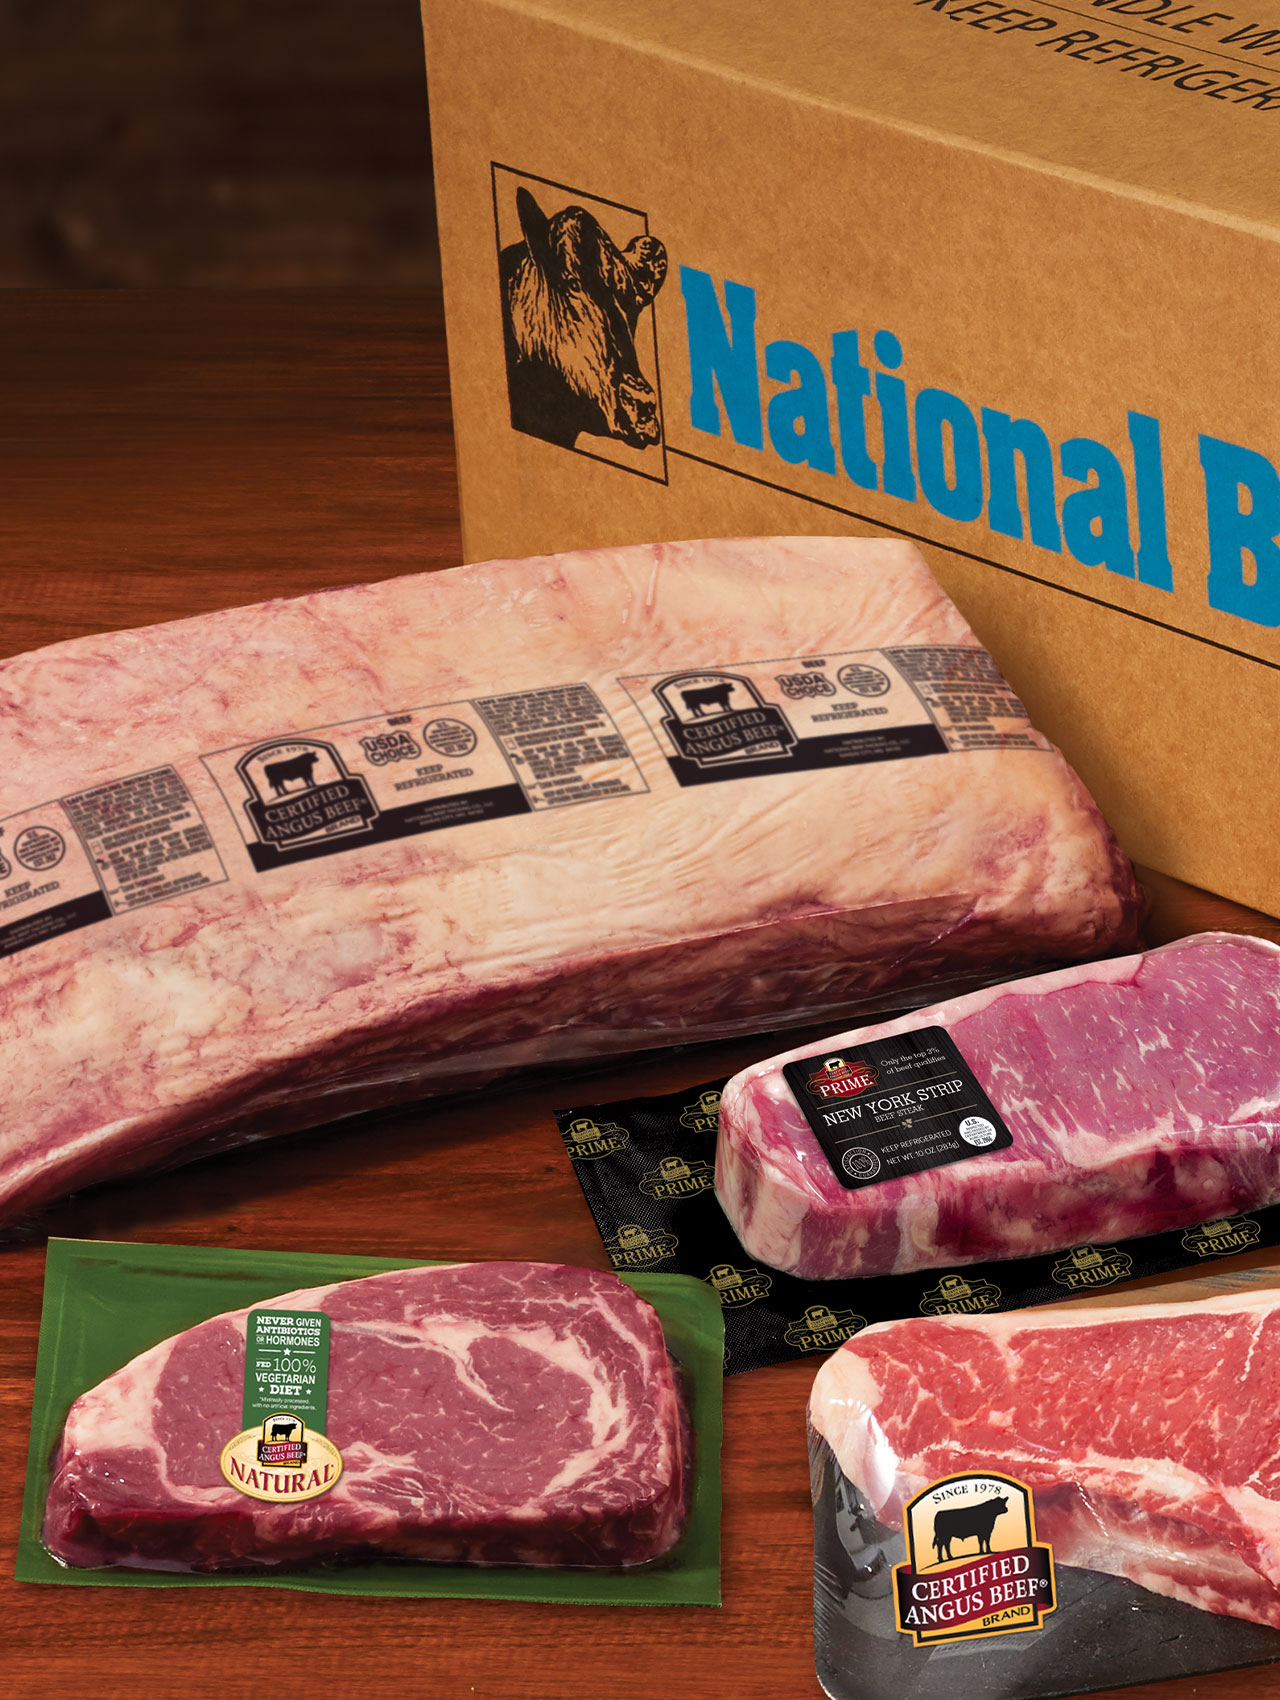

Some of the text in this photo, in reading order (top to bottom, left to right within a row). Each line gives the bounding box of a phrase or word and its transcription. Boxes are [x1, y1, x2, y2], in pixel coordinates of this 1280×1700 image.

[913, 0, 1057, 34] KEEP
[679, 264, 1174, 594] National
[365, 734, 411, 752] USDA
[371, 744, 417, 762] CHOICE
[820, 1074, 873, 1097] PRIME
[822, 1080, 963, 1127] NEW YORK STRIP
[874, 1104, 924, 1123] BEEF STEAK
[881, 1143, 899, 1154] KEEP
[900, 1130, 951, 1149] REFRIGERATED
[653, 1174, 712, 1198] PRIME
[256, 1316, 322, 1328] NEVER GIVEN
[256, 1327, 320, 1336] ANTIBIOTICS
[266, 1335, 320, 1347] HORMONES
[273, 1358, 317, 1373] 100%
[256, 1373, 315, 1384] VEGETARIAN
[270, 1385, 302, 1396] DIET
[230, 1456, 334, 1493] NATURAL
[912, 1555, 1030, 1601] CERTIFIED
[905, 1592, 983, 1625] ANGUS
[983, 1606, 1030, 1626] BRAND
